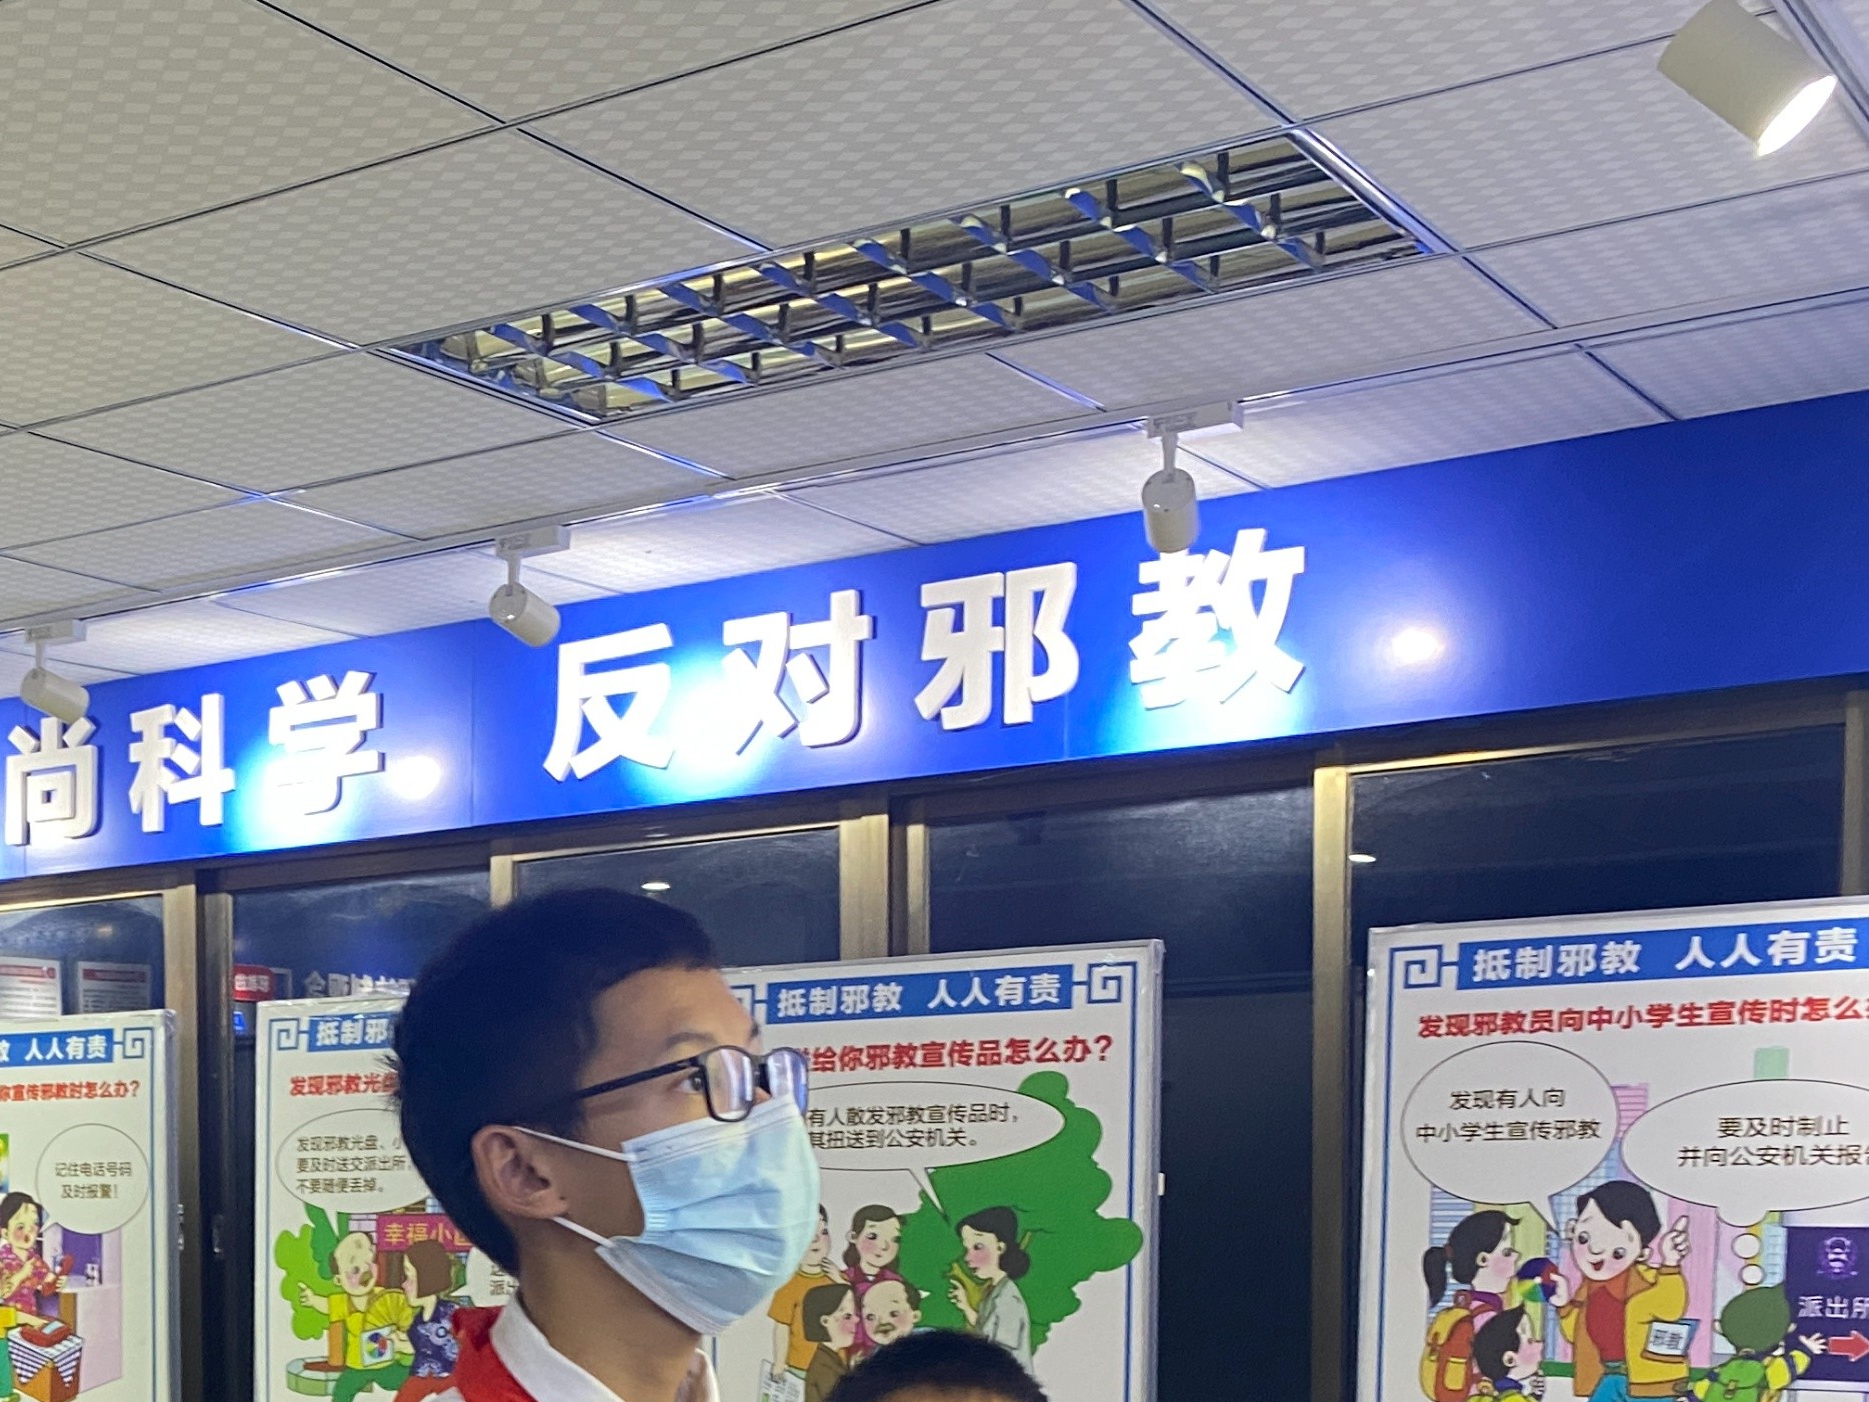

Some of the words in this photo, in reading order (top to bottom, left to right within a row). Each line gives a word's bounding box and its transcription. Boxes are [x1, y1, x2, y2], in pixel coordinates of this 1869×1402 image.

[543, 528, 1306, 781] 反对邪教
[1472, 940, 1643, 983] 抵制邪教
[1675, 926, 1858, 971] 人人有责
[777, 981, 904, 1018] 抵制邪教
[928, 973, 1060, 1010] 人人有责
[1417, 996, 1869, 1039] 发现邪教员向中小学生宣传时怎么
[315, 1016, 394, 1046] 抵制邪
[24, 1034, 107, 1061] 人人有责
[1449, 1087, 1565, 1111] 发现有人向
[1415, 1118, 1603, 1143] 中小学生宣传邪教
[1717, 1115, 1850, 1138] 要及时制止
[55, 1161, 132, 1177] 记住电话号码
[296, 1177, 384, 1194] 不要随便丢掉。
[1798, 1295, 1869, 1319] 派出所
